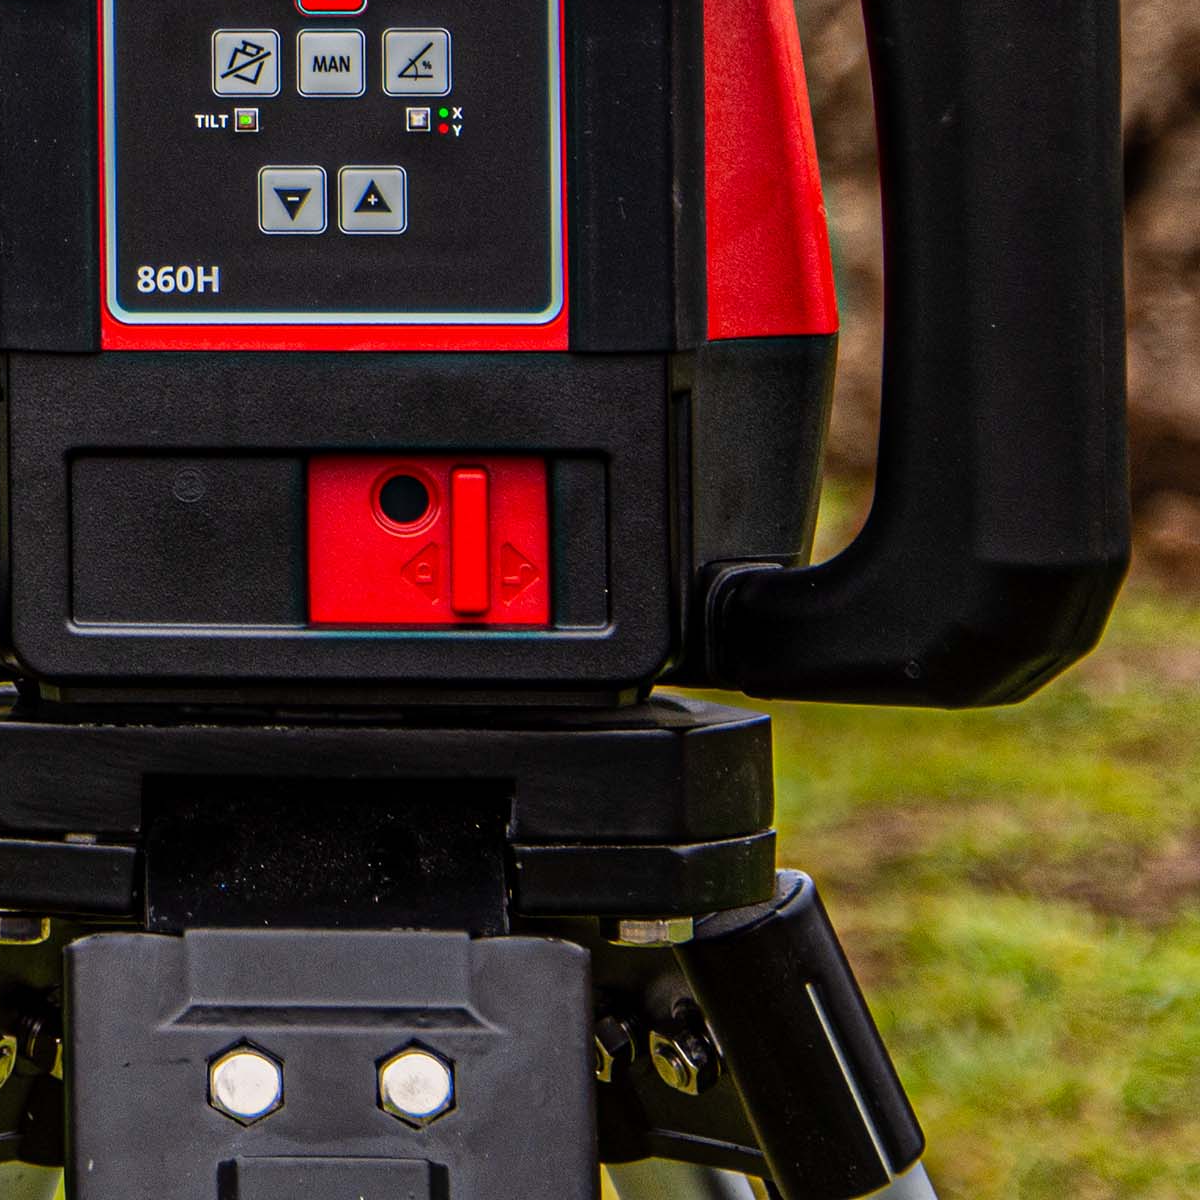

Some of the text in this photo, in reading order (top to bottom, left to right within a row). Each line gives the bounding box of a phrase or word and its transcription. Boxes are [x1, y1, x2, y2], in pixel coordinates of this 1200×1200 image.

[312, 55, 350, 73] MAN
[194, 113, 229, 128] TILT
[452, 106, 463, 120] X
[453, 124, 463, 137] Y
[137, 265, 220, 293] 860H
